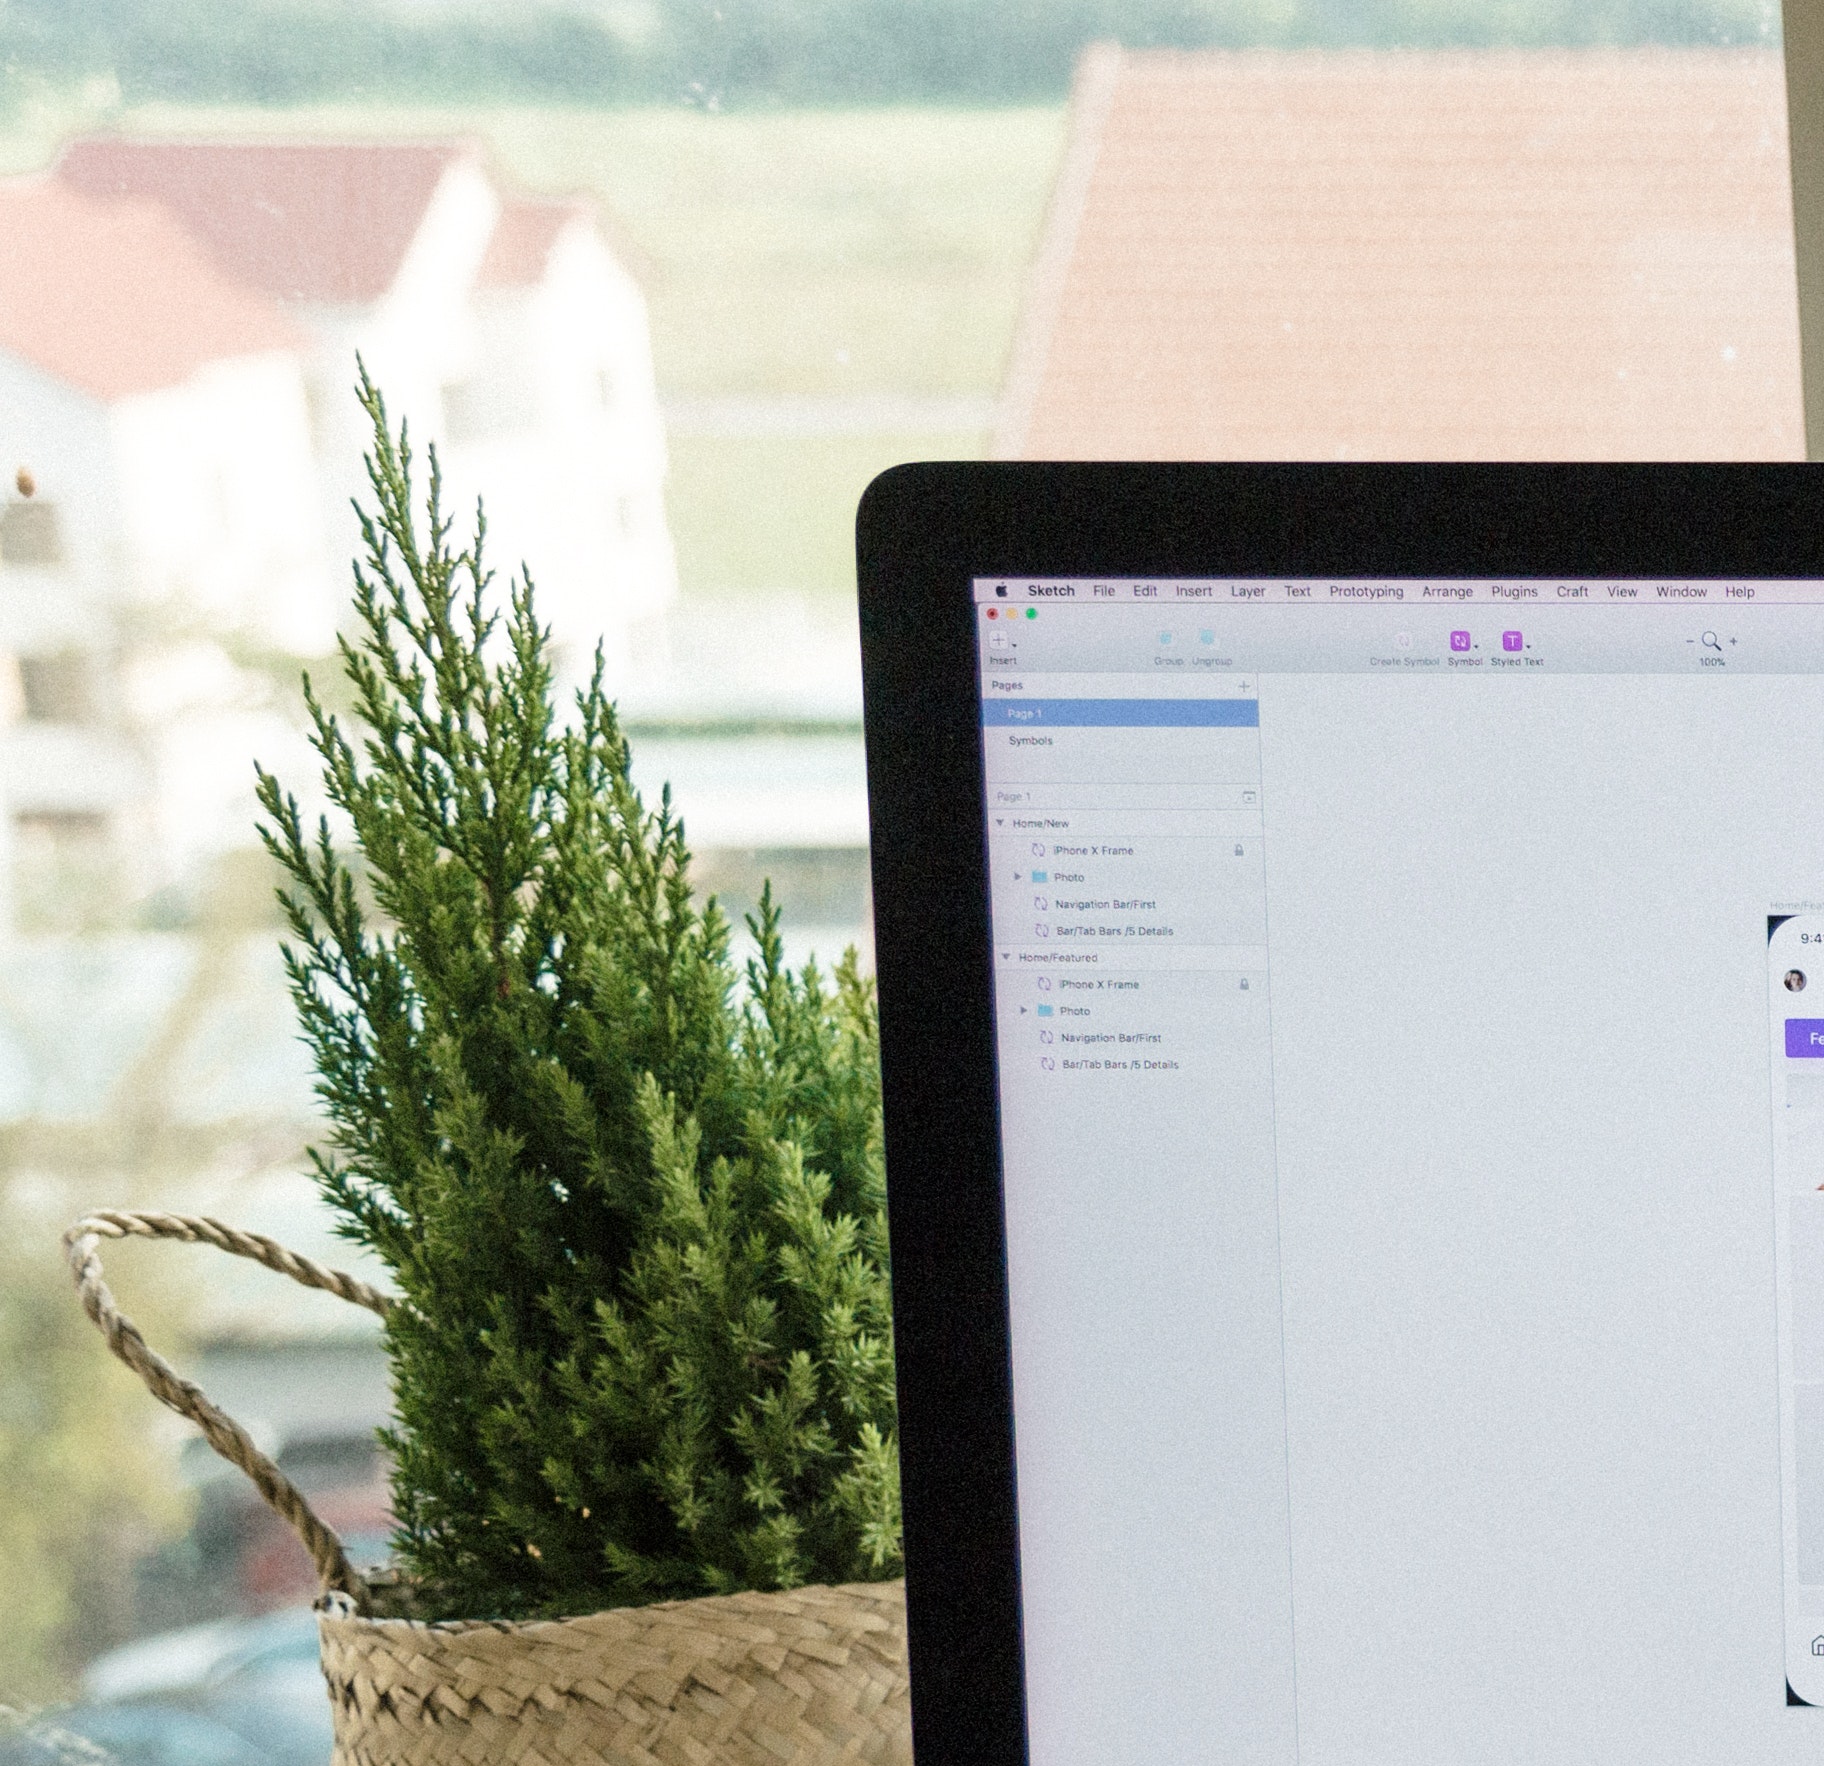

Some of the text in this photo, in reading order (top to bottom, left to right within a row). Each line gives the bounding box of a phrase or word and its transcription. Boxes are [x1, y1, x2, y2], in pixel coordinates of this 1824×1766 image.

[1028, 585, 1755, 600] Sketch File Edit Insert Layer Text Prototyping Arrange Plugins Craft View Window Help
[990, 657, 1017, 666] Insert
[1154, 657, 1184, 667] Group
[1192, 658, 1232, 667] Ungroup
[1370, 657, 1439, 667] Create Symbol
[1448, 657, 1483, 667] Symbol
[1491, 657, 1544, 667] Styled Text
[1700, 658, 1725, 667] 100%
[992, 681, 1023, 691] Pages
[1007, 708, 1035, 720] Page
[1009, 736, 1053, 747] Symbols
[996, 791, 1024, 804] Page
[1013, 819, 1069, 829] Home/New
[1054, 846, 1133, 856] iPhone X Frame
[1054, 872, 1084, 882] Photo
[1056, 899, 1156, 910] Navigation Bar/First
[1057, 926, 1173, 936] Bar/Tab Bars /5 Details
[1018, 951, 1099, 964] Home/Featured
[1060, 979, 1139, 989] iPhone X Frame
[1060, 1006, 1090, 1016] Photo
[1062, 1033, 1161, 1043] Navigation Bar/First
[1063, 1059, 1179, 1070] Bar/Tab Bars /5 Details
